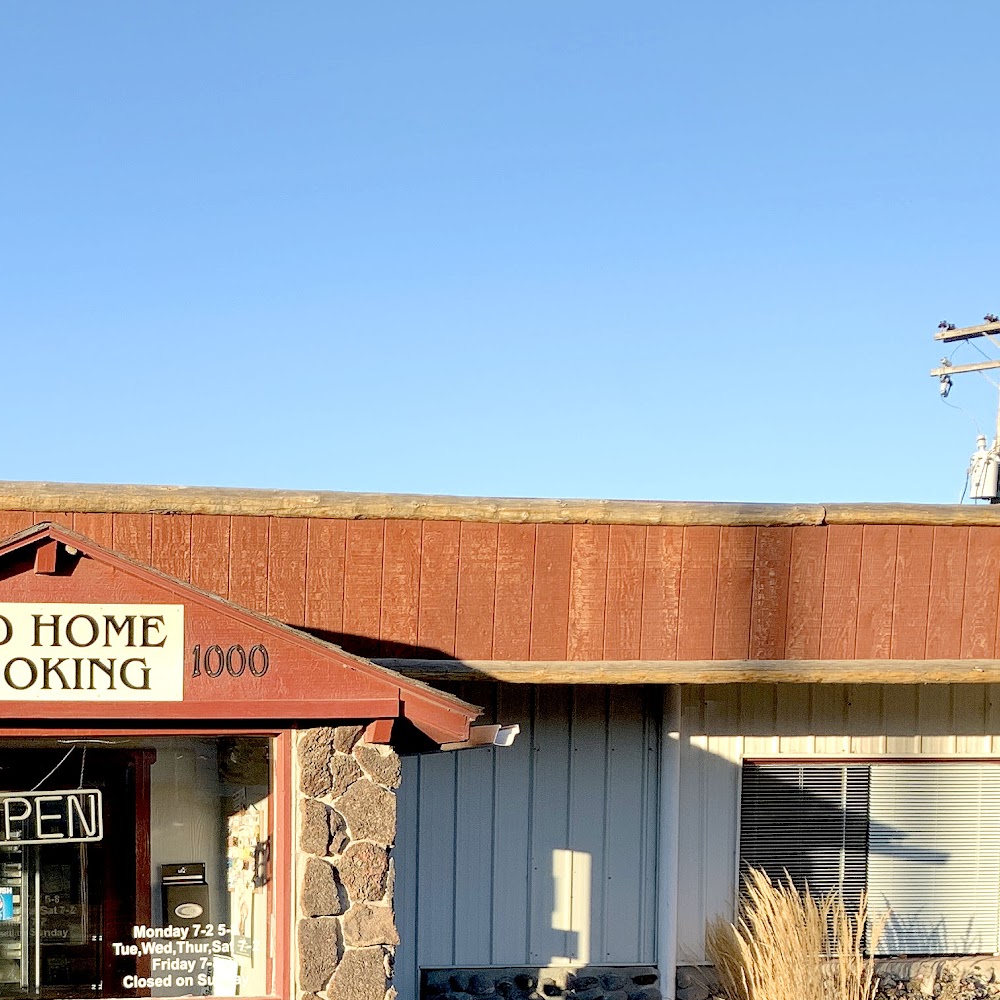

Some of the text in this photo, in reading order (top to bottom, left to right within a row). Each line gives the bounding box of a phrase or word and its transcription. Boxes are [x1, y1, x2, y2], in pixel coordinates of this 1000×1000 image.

[31, 614, 168, 648] HOME
[191, 643, 270, 679] 1000
[133, 924, 190, 940] Monday
[192, 924, 214, 937] 7-2
[112, 939, 234, 957] Tue,Wed,Thur,Sat
[152, 957, 197, 973] Friday
[123, 974, 172, 988] Closed
[175, 977, 194, 987] on
